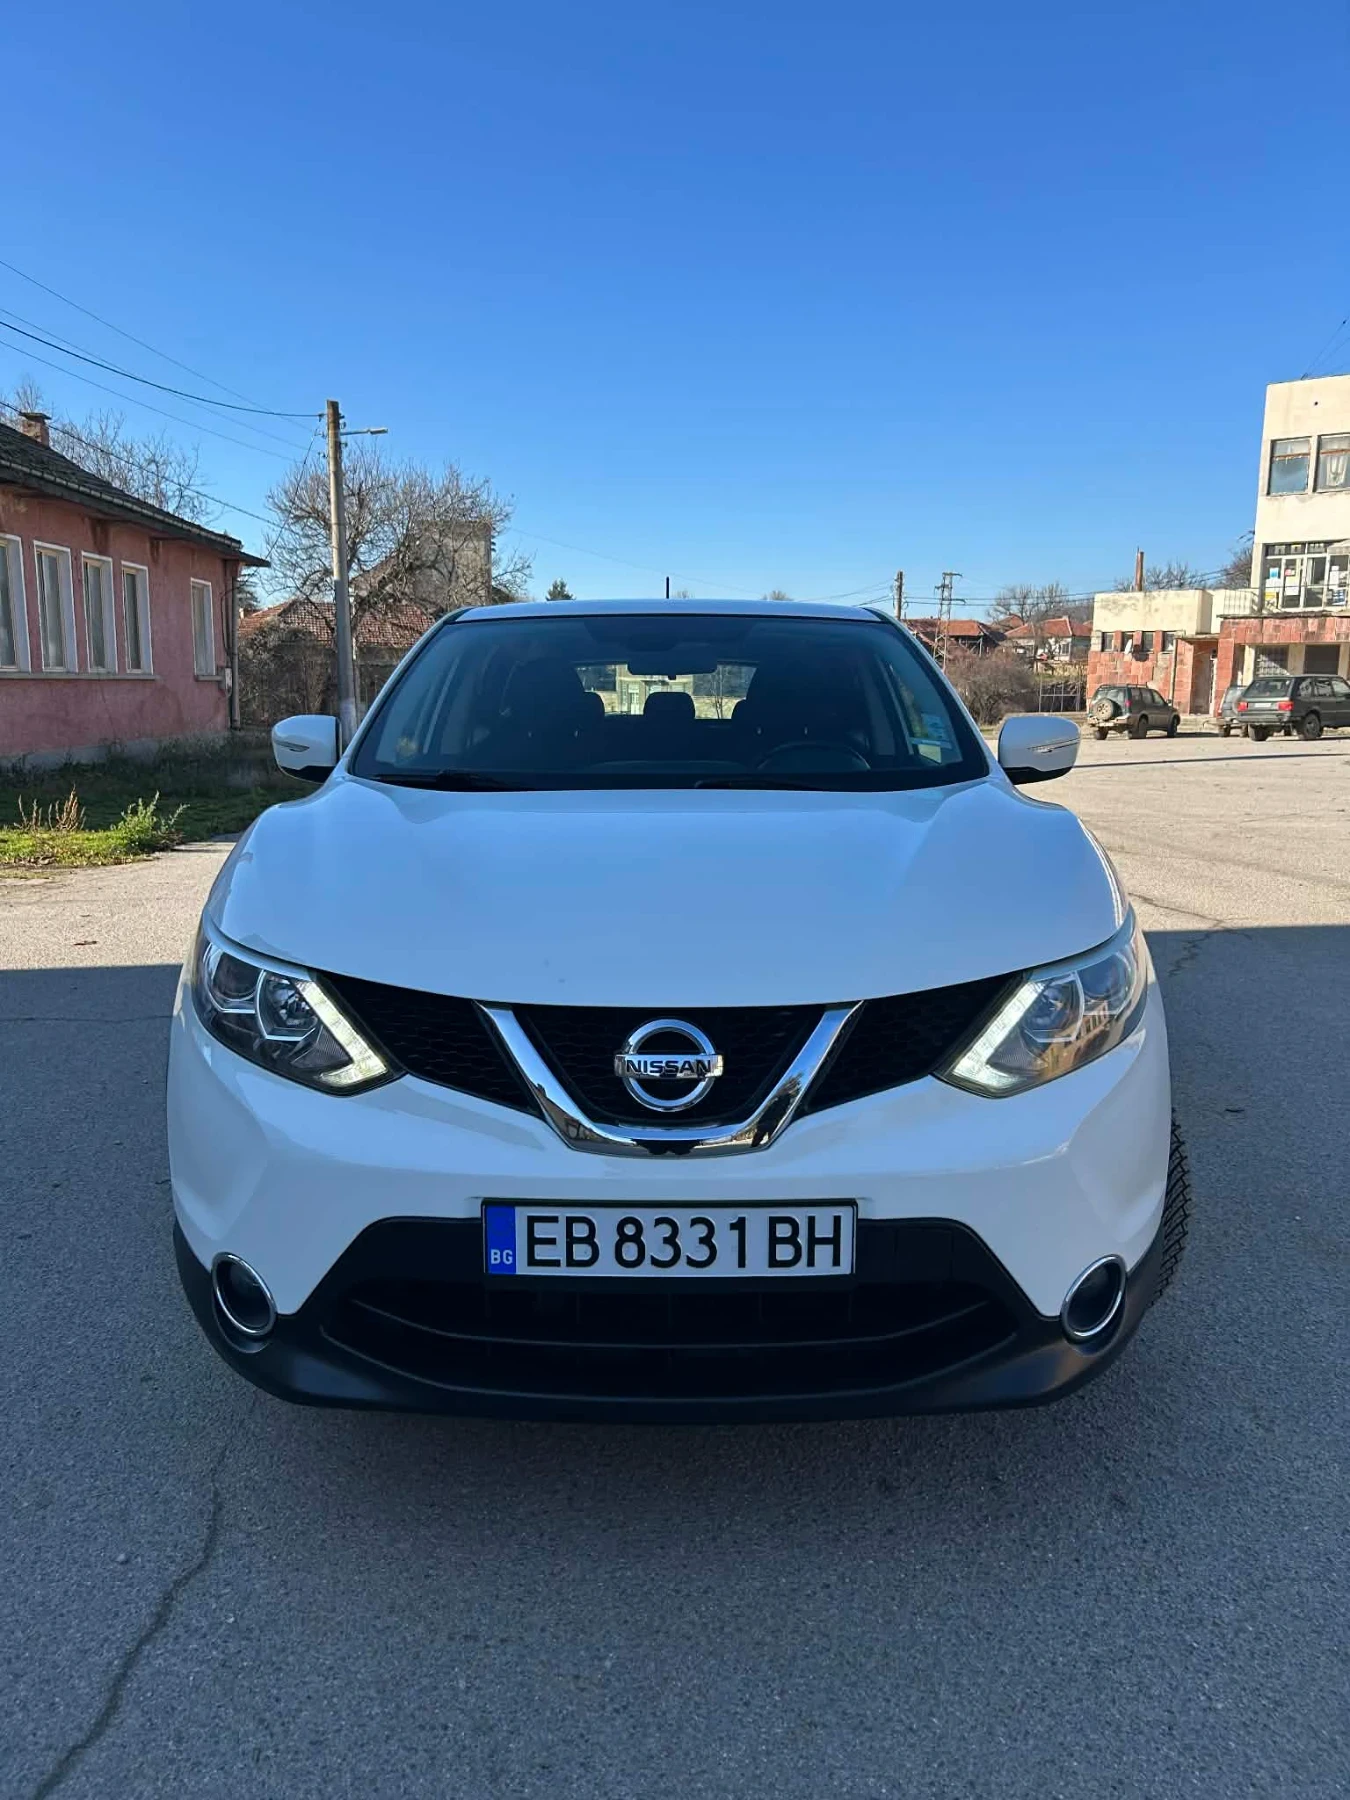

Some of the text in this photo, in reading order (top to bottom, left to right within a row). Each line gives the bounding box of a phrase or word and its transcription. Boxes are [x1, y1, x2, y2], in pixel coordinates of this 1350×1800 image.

[625, 1059, 711, 1074] NISSAN
[526, 1214, 842, 1269] EB 8331 BH
[489, 1249, 513, 1265] BG
